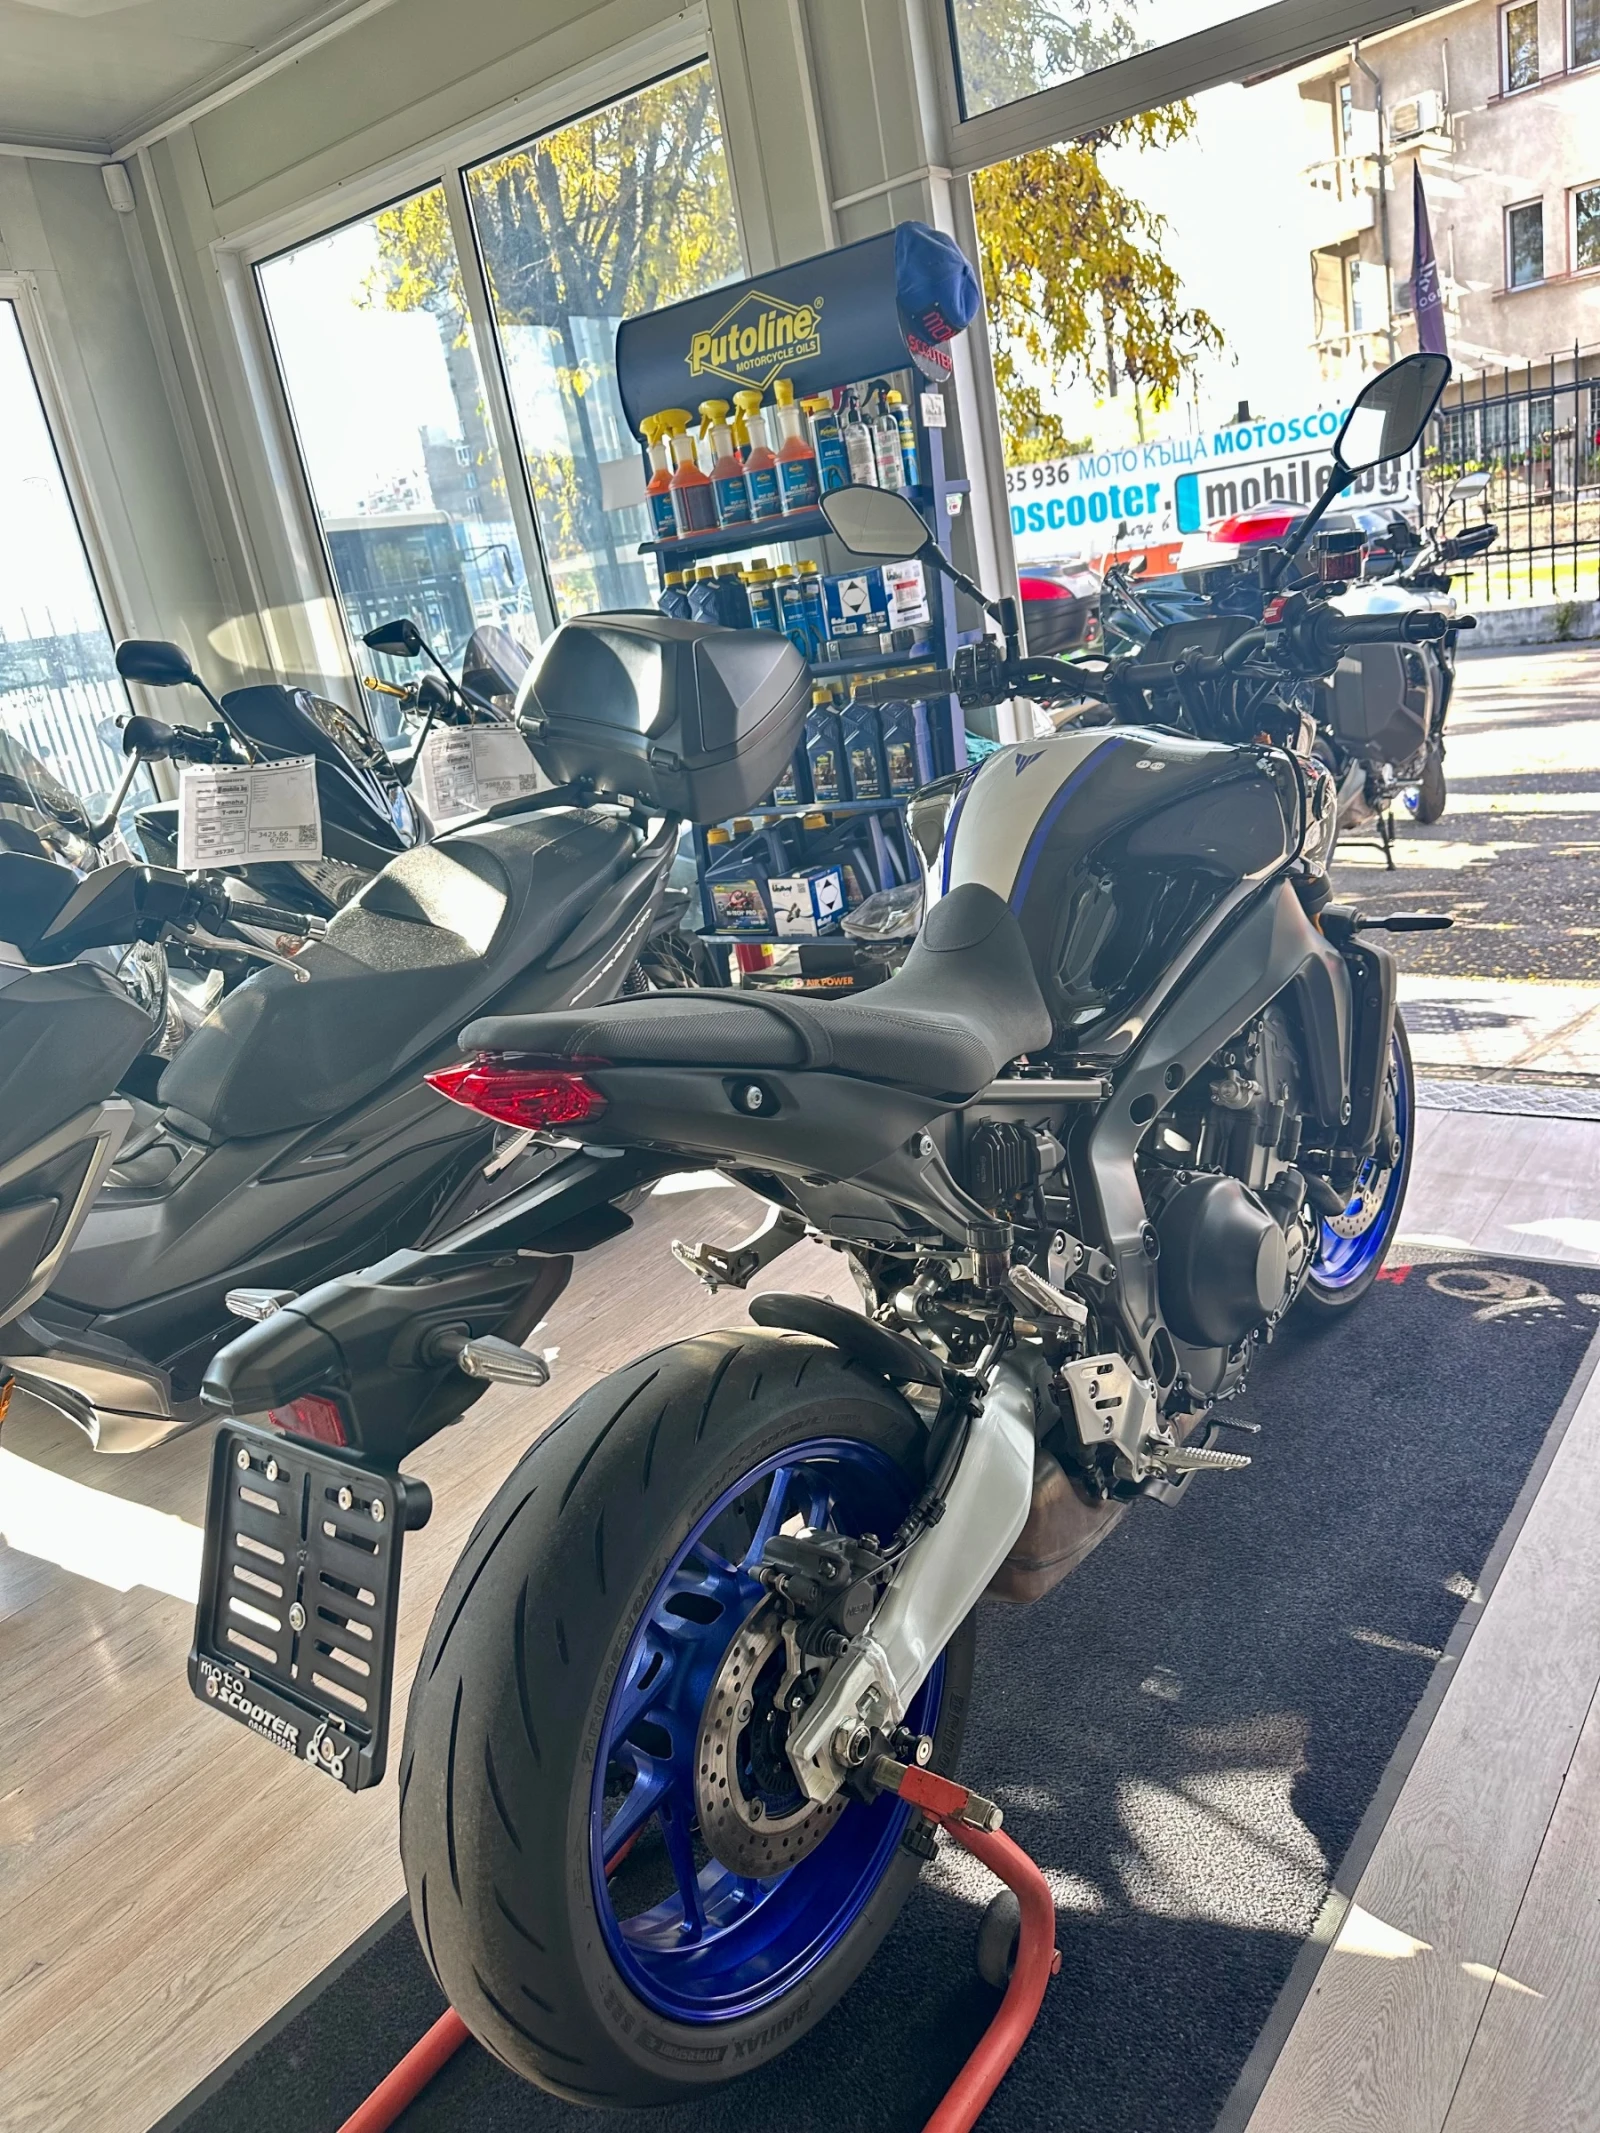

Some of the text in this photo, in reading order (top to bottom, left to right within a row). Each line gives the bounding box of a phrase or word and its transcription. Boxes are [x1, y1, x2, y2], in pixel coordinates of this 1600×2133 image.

[693, 308, 813, 372] Putoline
[735, 340, 816, 373] MOTORCYCLE OILS
[1032, 462, 1069, 489] 936
[1078, 449, 1137, 481] МОТО
[1143, 437, 1207, 469] КЪЩА
[214, 848, 235, 856] 35730
[806, 979, 819, 987] AIR
[820, 977, 854, 987] POWER
[201, 1661, 244, 1694] moto
[218, 1686, 299, 1744] SCOOTER
